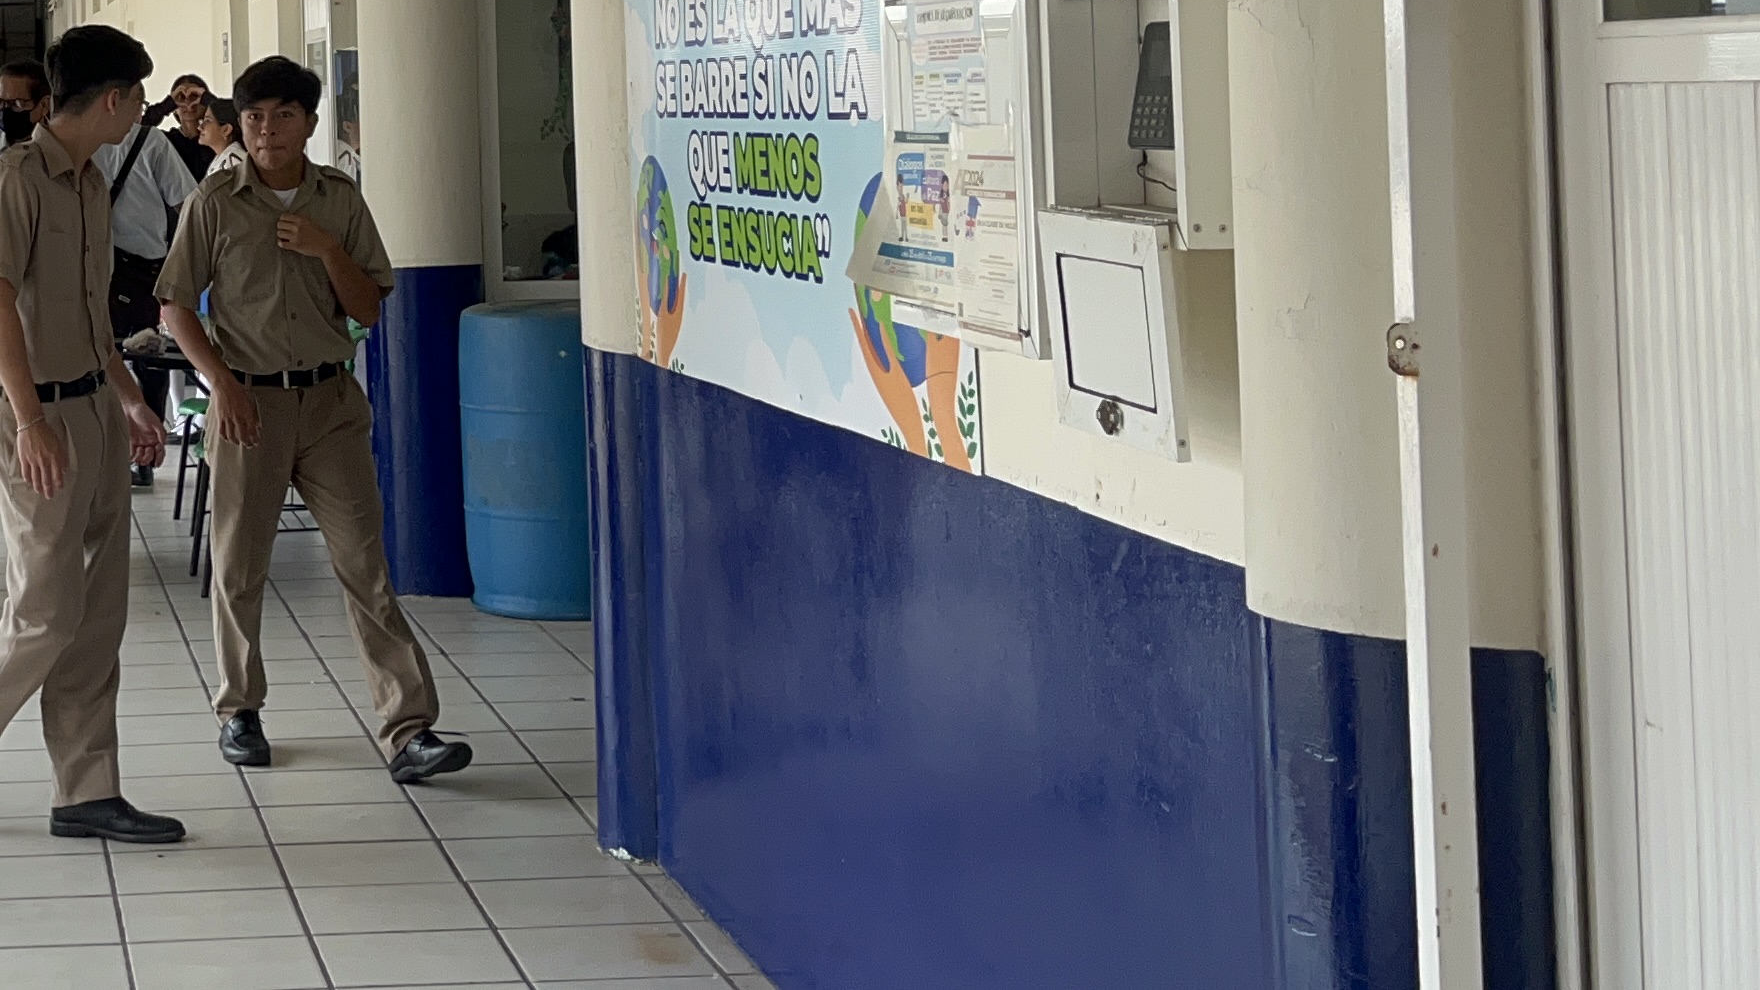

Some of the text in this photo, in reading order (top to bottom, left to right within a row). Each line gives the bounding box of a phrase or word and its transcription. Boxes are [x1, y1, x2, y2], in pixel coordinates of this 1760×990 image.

[656, 60, 677, 118] SE
[679, 56, 749, 118] BARRE
[752, 54, 776, 120] SI
[779, 50, 820, 121] NO
[825, 48, 868, 120] LA
[688, 129, 822, 203] QUE MENOS
[688, 201, 716, 263] SE
